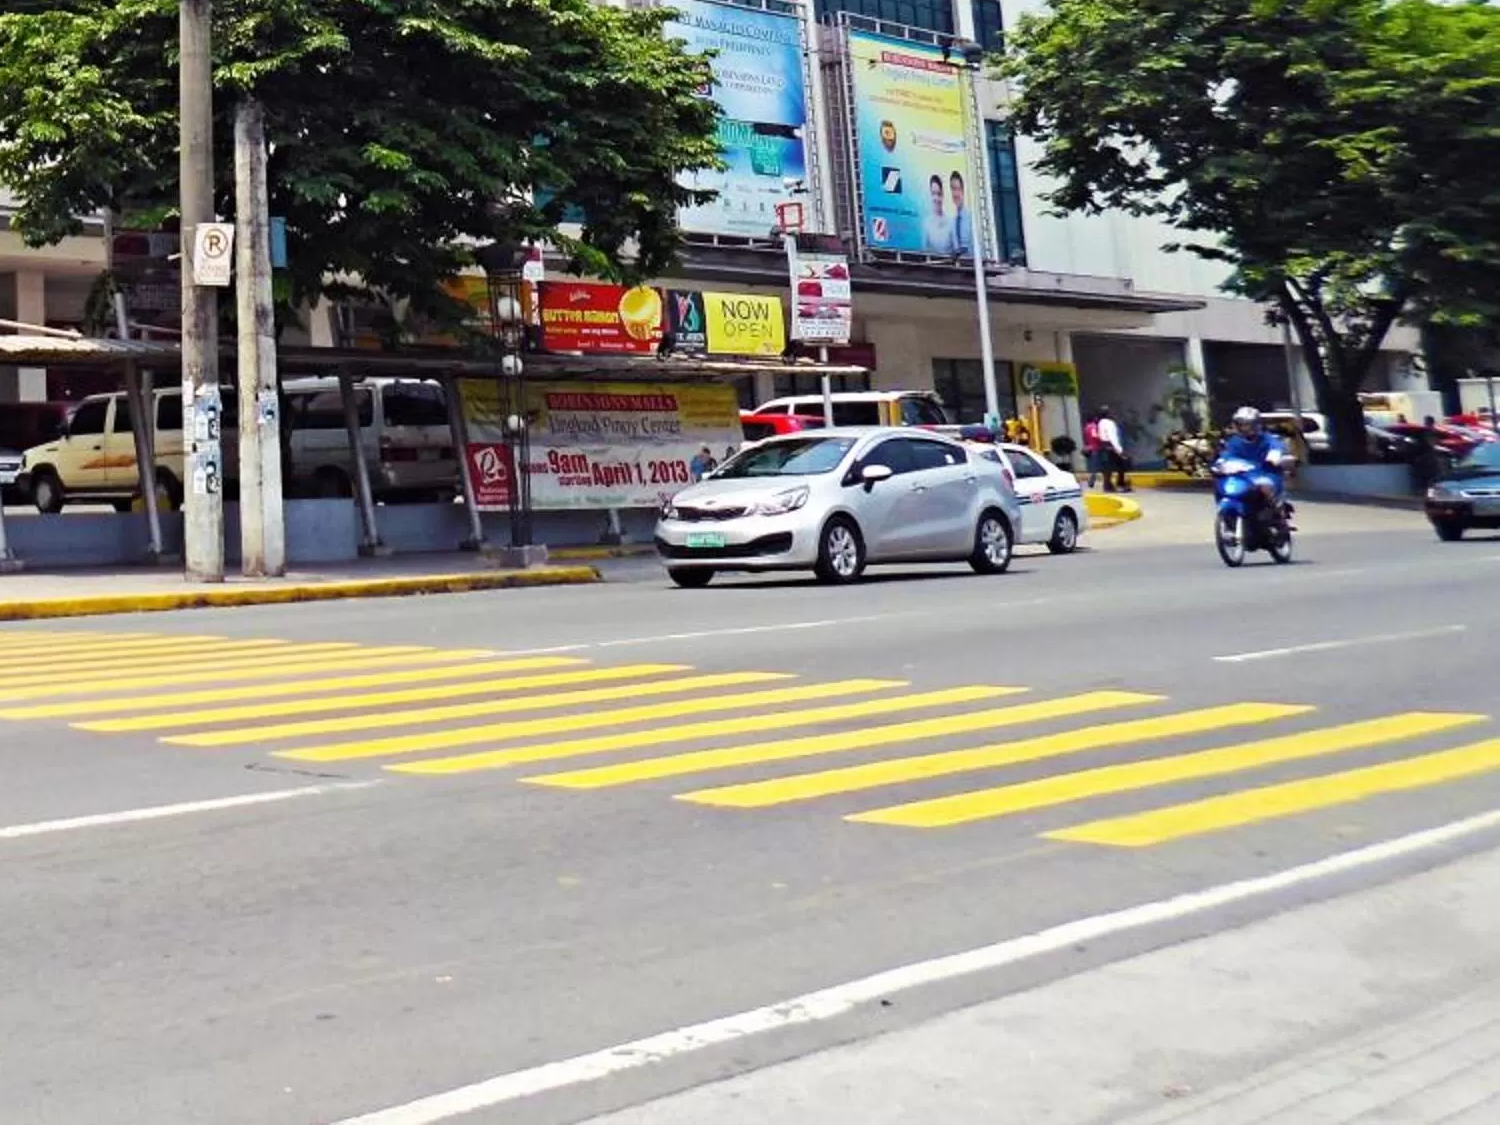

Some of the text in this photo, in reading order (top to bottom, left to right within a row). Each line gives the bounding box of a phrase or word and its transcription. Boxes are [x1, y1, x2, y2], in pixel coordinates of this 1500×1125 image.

[721, 299, 770, 321] NOW
[723, 322, 773, 339] OPEN
[547, 449, 589, 474] 9am
[591, 461, 633, 487] April
[648, 459, 688, 484] 2013
